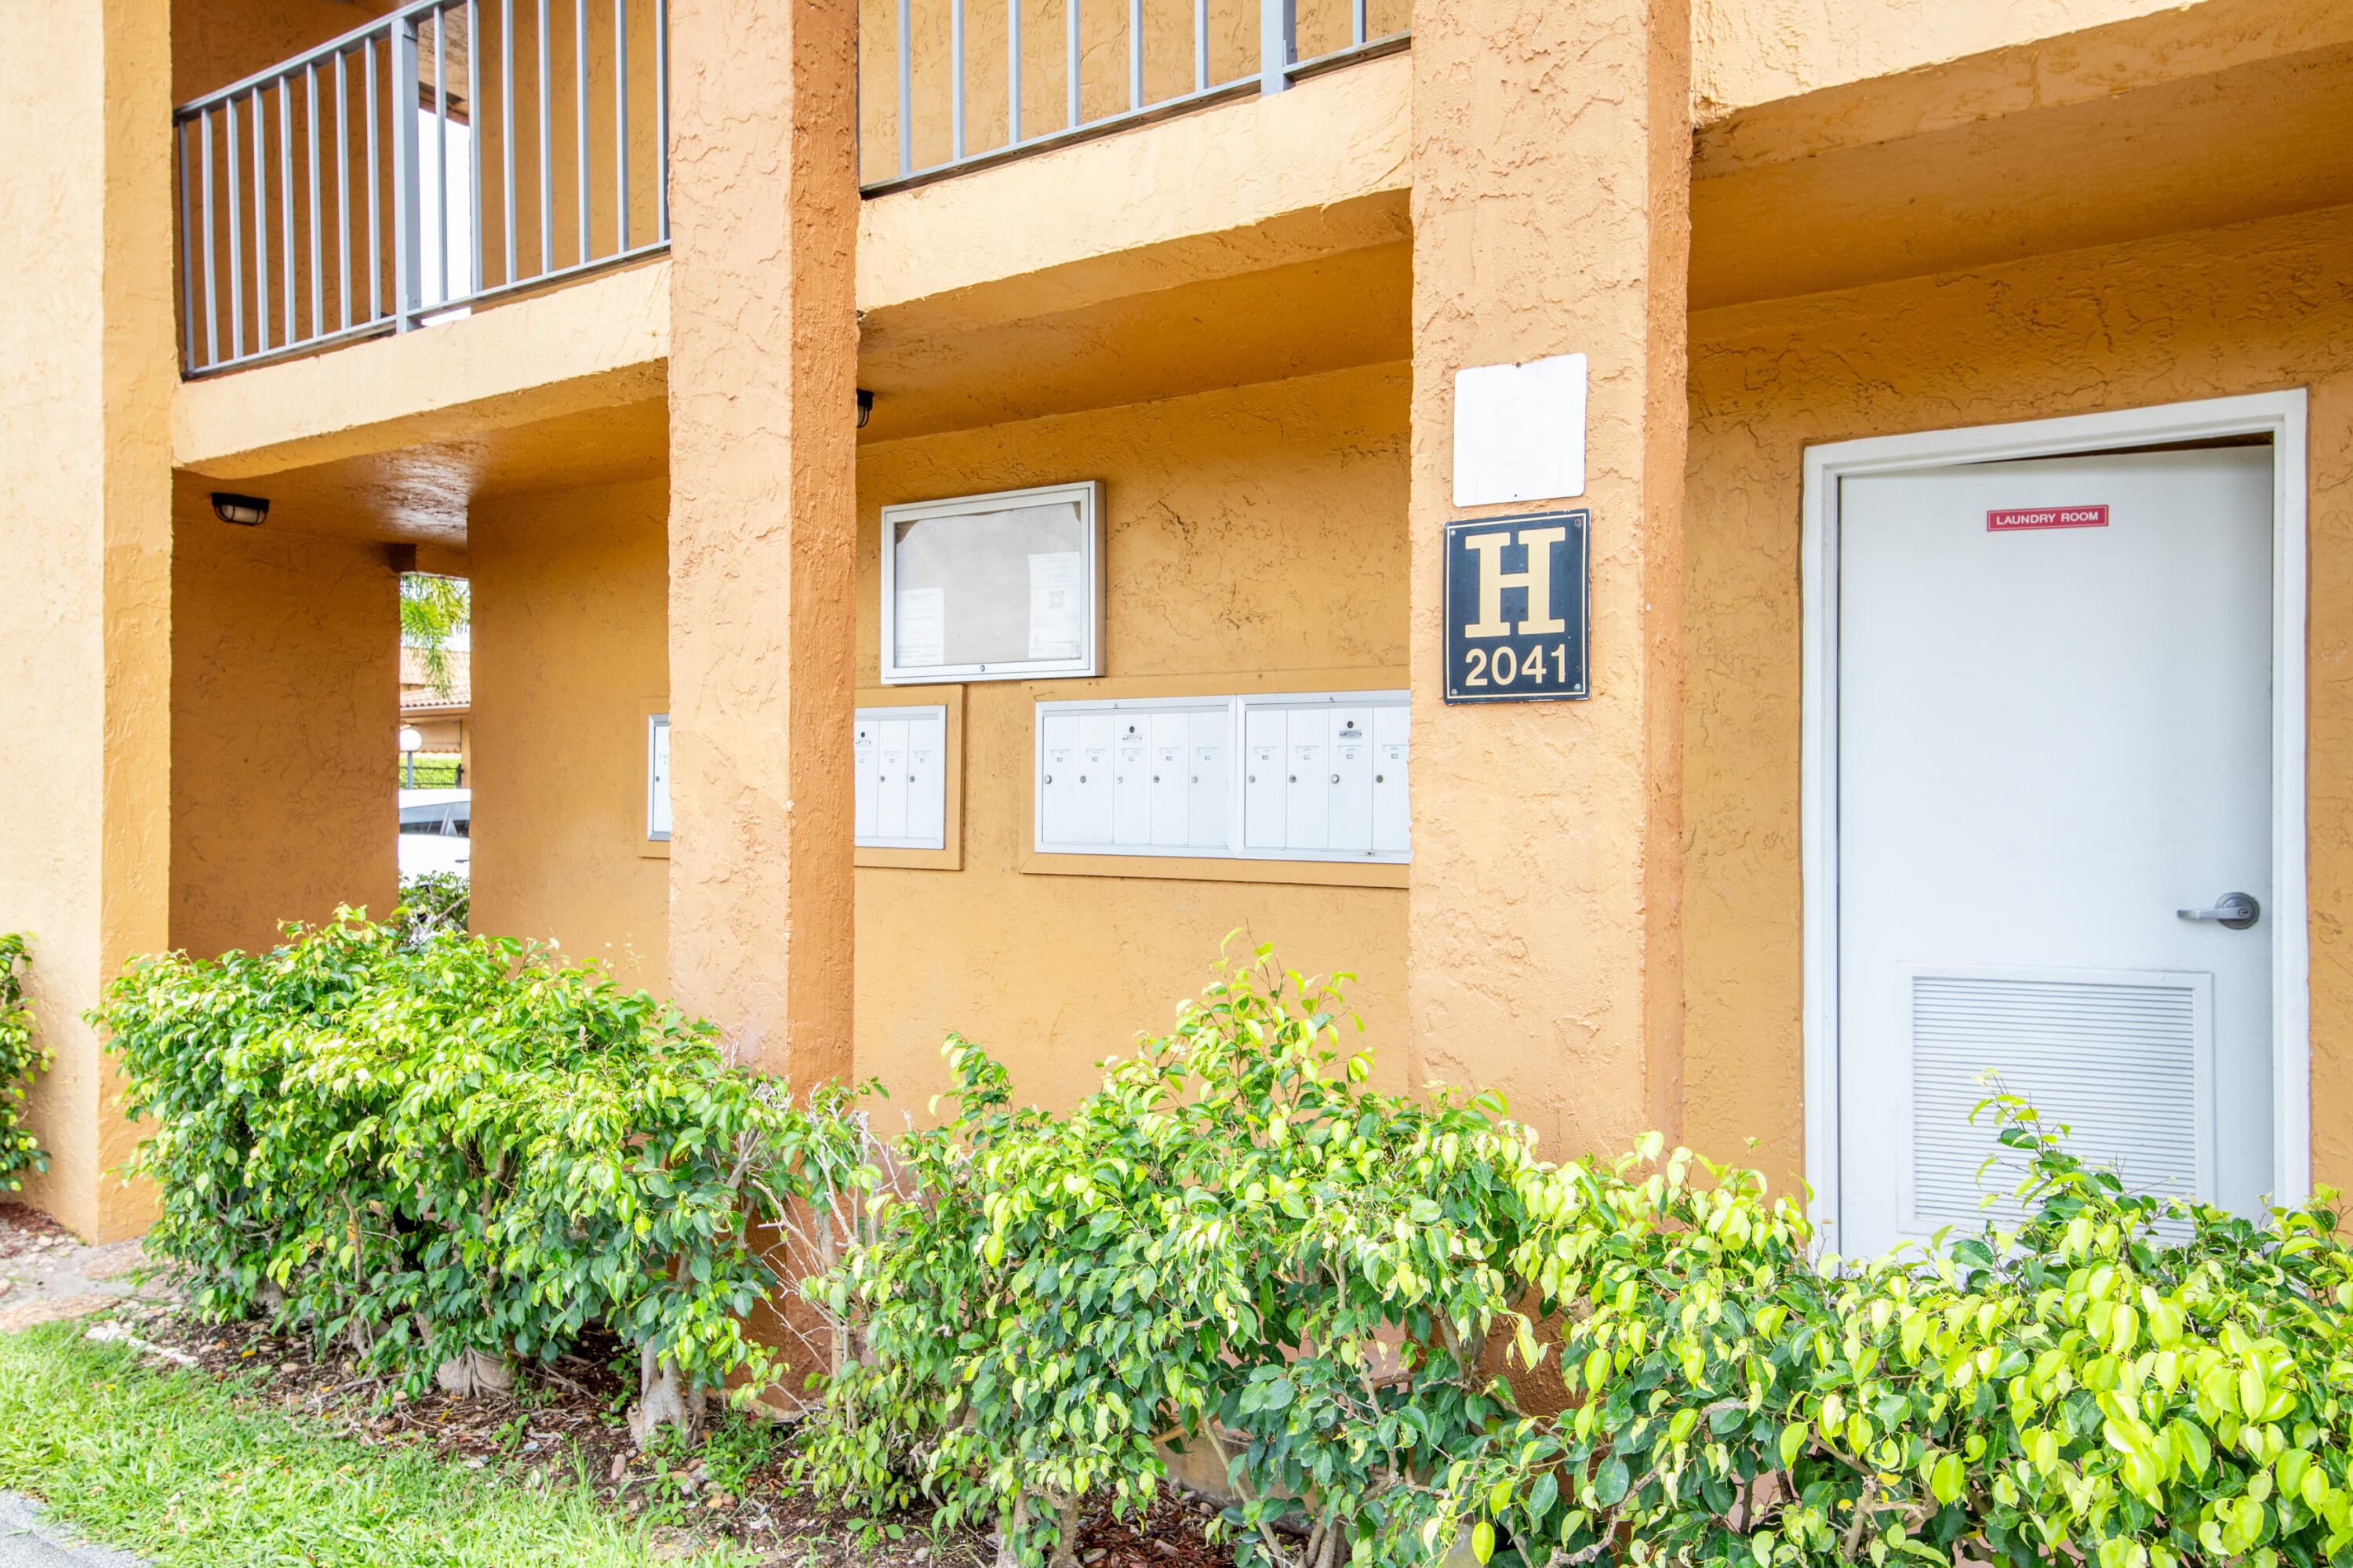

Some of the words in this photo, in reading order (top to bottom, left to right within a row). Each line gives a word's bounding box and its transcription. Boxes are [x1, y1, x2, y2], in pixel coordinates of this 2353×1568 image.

[1996, 513, 2056, 526] LAUNDRY
[2060, 511, 2099, 522] ROOM
[1465, 527, 1566, 638] H
[1465, 644, 1566, 686] 2041
